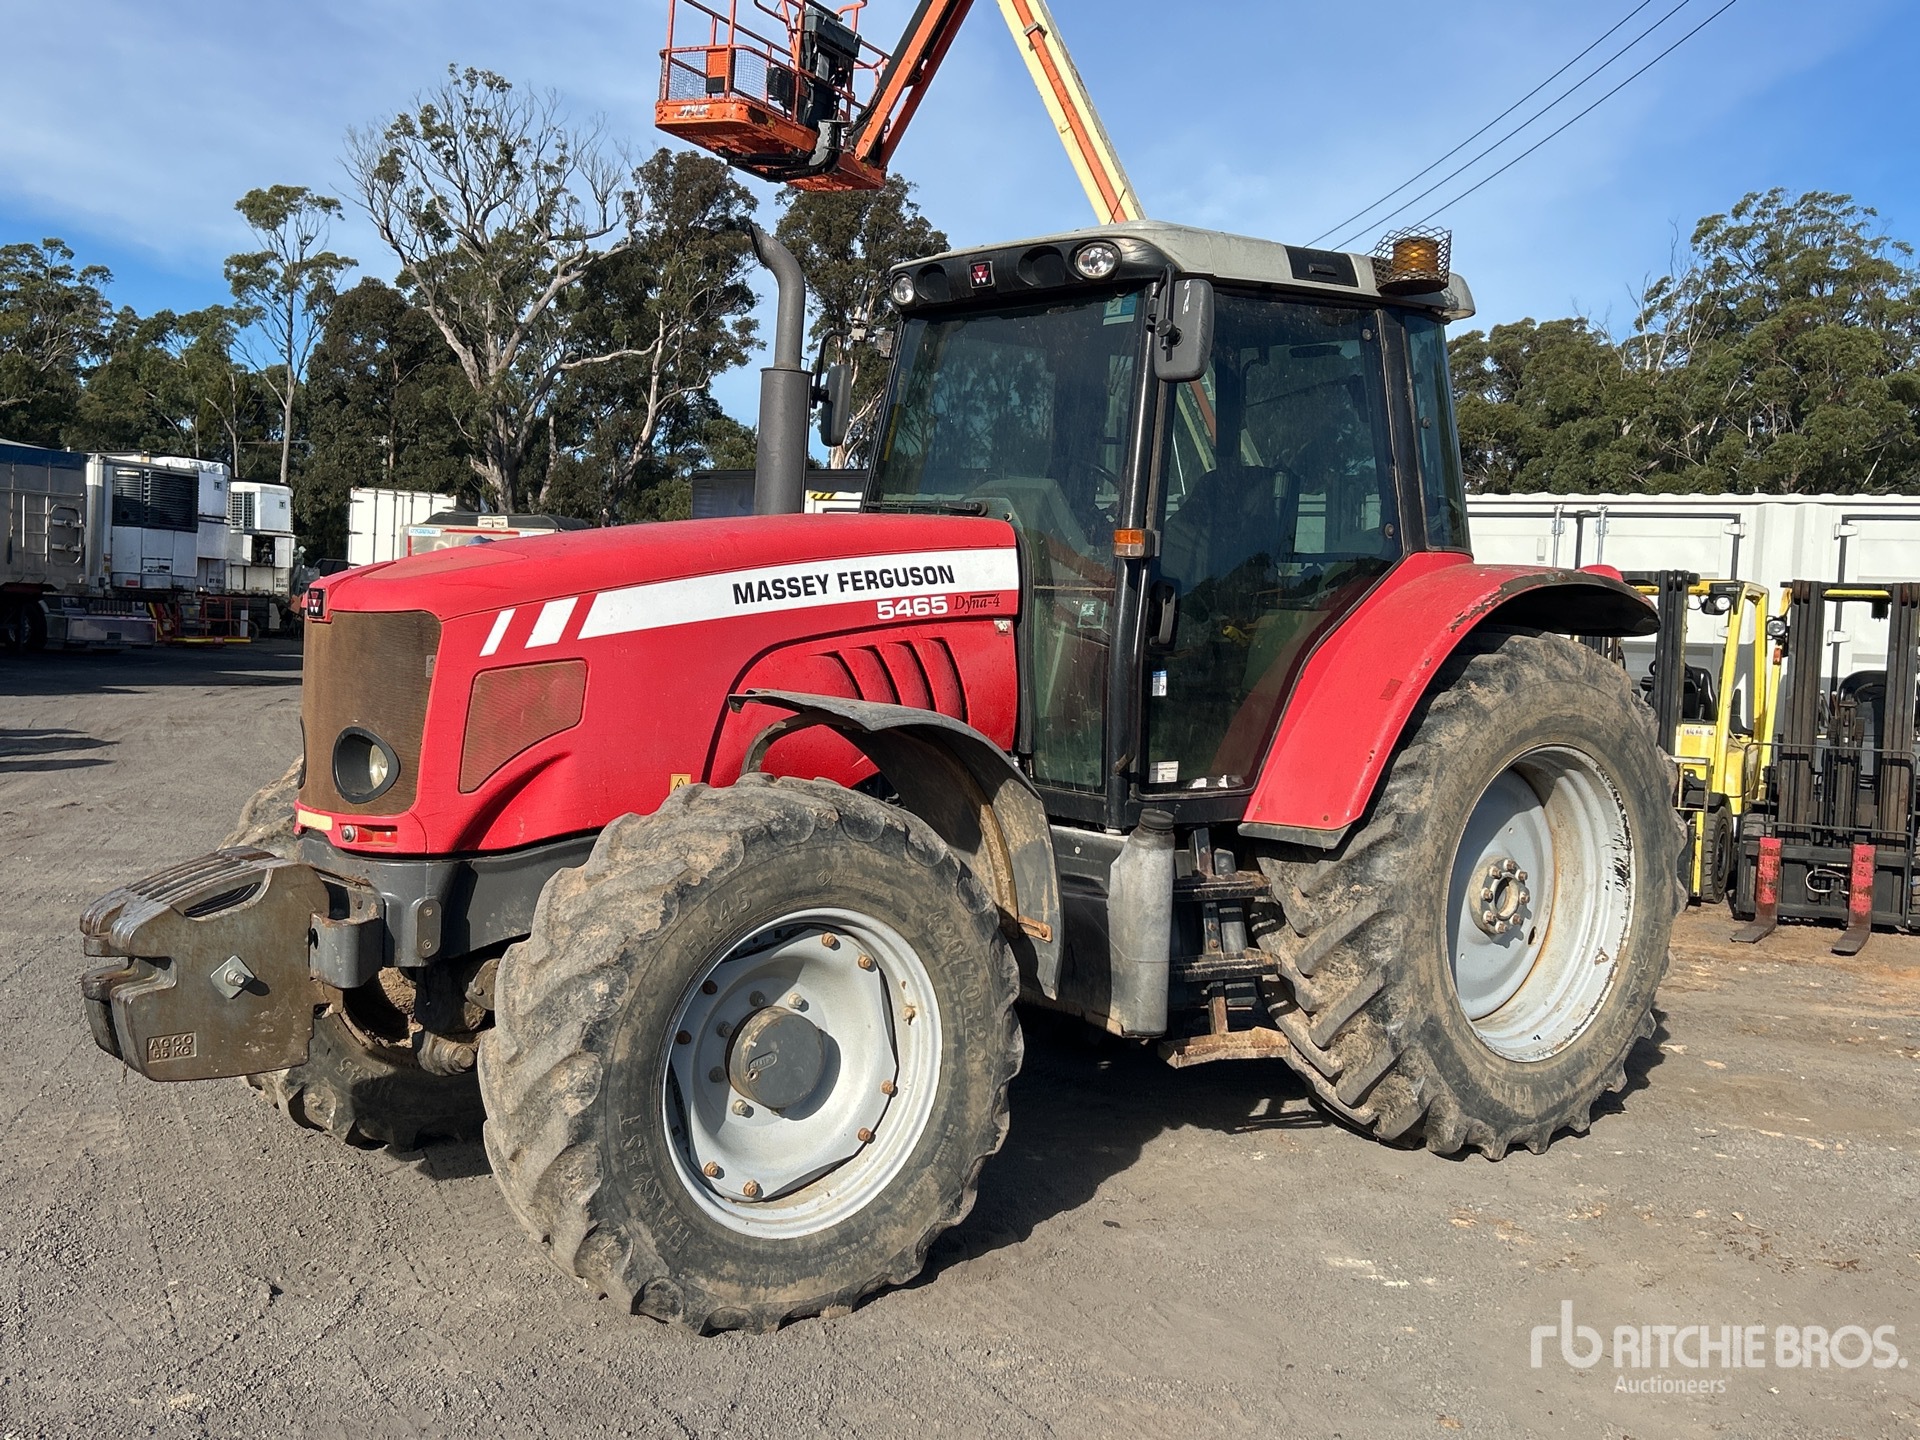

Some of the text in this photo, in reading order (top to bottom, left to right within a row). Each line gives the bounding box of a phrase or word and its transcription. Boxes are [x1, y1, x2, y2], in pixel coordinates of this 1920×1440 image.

[733, 565, 955, 605] MASSEY FERGUSON
[876, 596, 948, 620] 5465
[954, 593, 1000, 614] Dyna-4
[678, 886, 752, 960] HR45
[149, 1034, 194, 1050] AGCO
[153, 1045, 191, 1059] 55 KG
